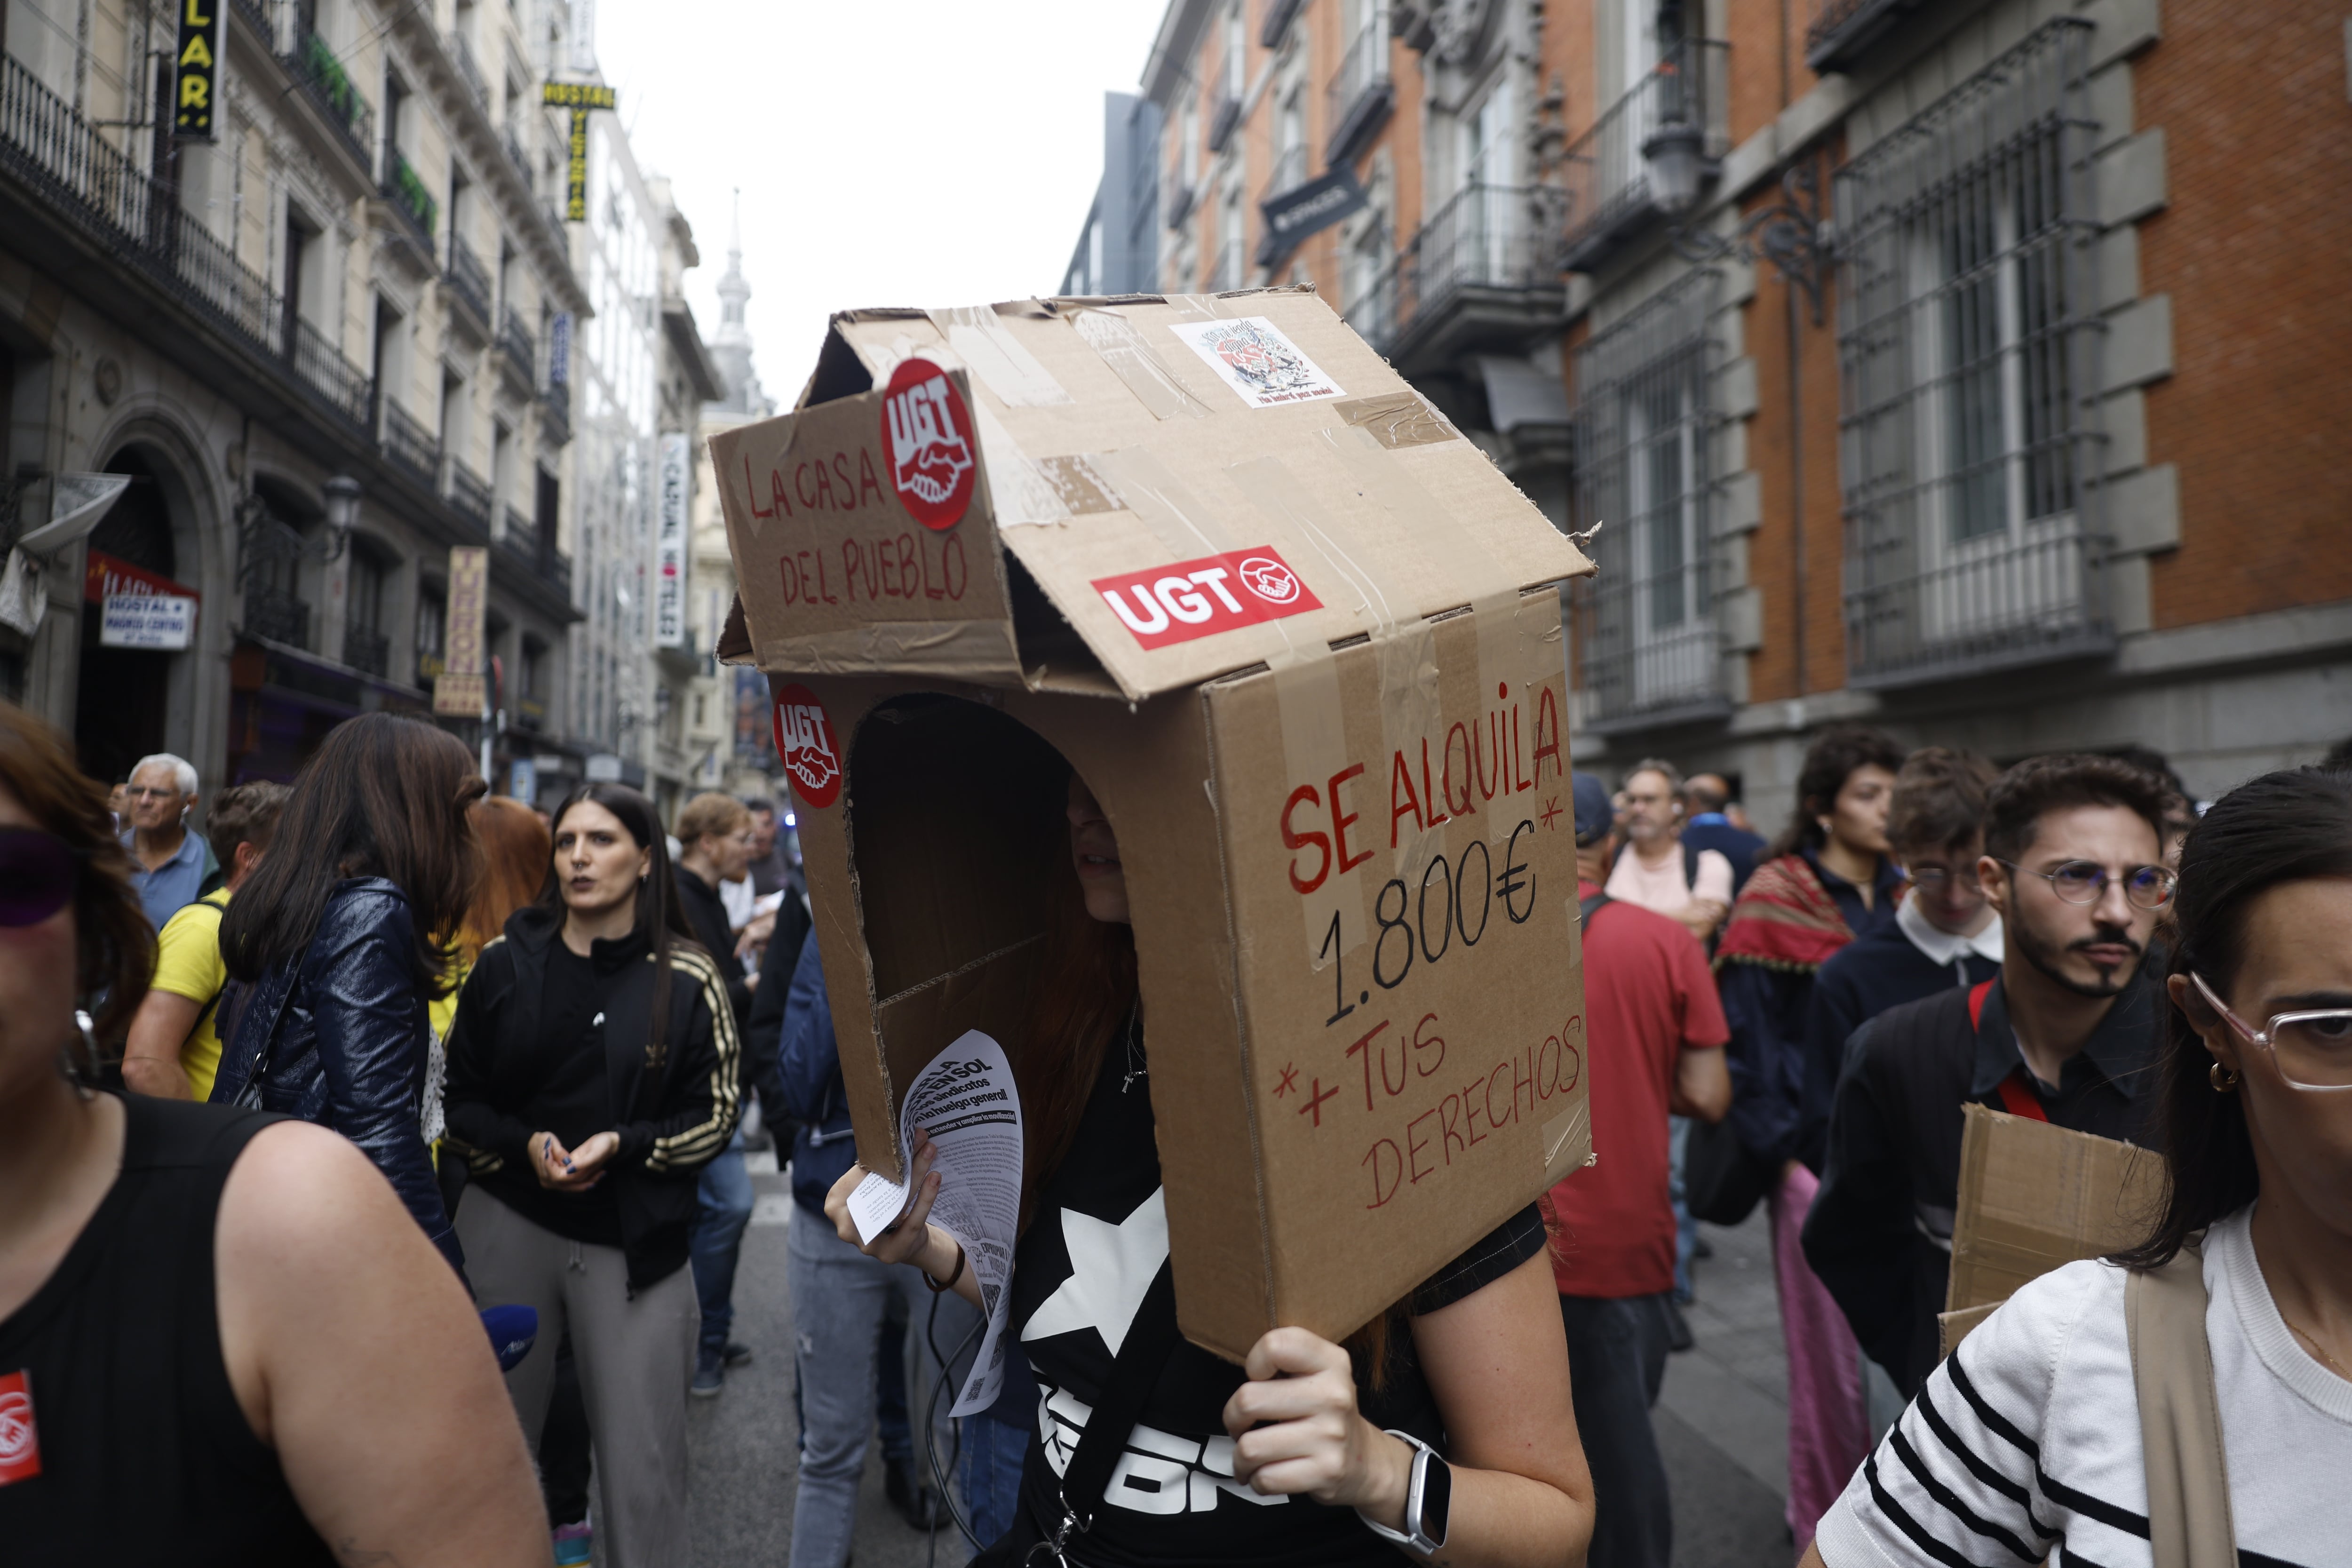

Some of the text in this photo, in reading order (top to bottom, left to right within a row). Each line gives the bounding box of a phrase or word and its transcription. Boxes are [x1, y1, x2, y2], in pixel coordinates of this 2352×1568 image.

[544, 83, 614, 107] HOSTAL
[1220, 319, 1254, 340] vivienda
[1224, 336, 1250, 354] digna
[1297, 391, 1311, 400] paz
[1313, 386, 1334, 396] social
[886, 374, 964, 463] UGT
[744, 446, 884, 520] LA CASA
[780, 531, 967, 607] DEL PUEBLO
[109, 597, 167, 611] HOSTAL
[1103, 567, 1243, 634] UGT
[779, 704, 831, 755] UGT
[1280, 762, 1375, 894] SE
[926, 1059, 993, 1090] EN SOL
[928, 1061, 961, 1076] LA
[1346, 1012, 1445, 1112] TUS
[923, 1089, 1008, 1119] la huelga general!
[933, 1078, 990, 1101] sindicatos
[930, 1121, 956, 1136] extender
[961, 1115, 983, 1125] ampliar
[988, 1112, 1015, 1121] movilización!
[1361, 1015, 1581, 1210] DERECHOS
[869, 1200, 891, 1219] Acampada
